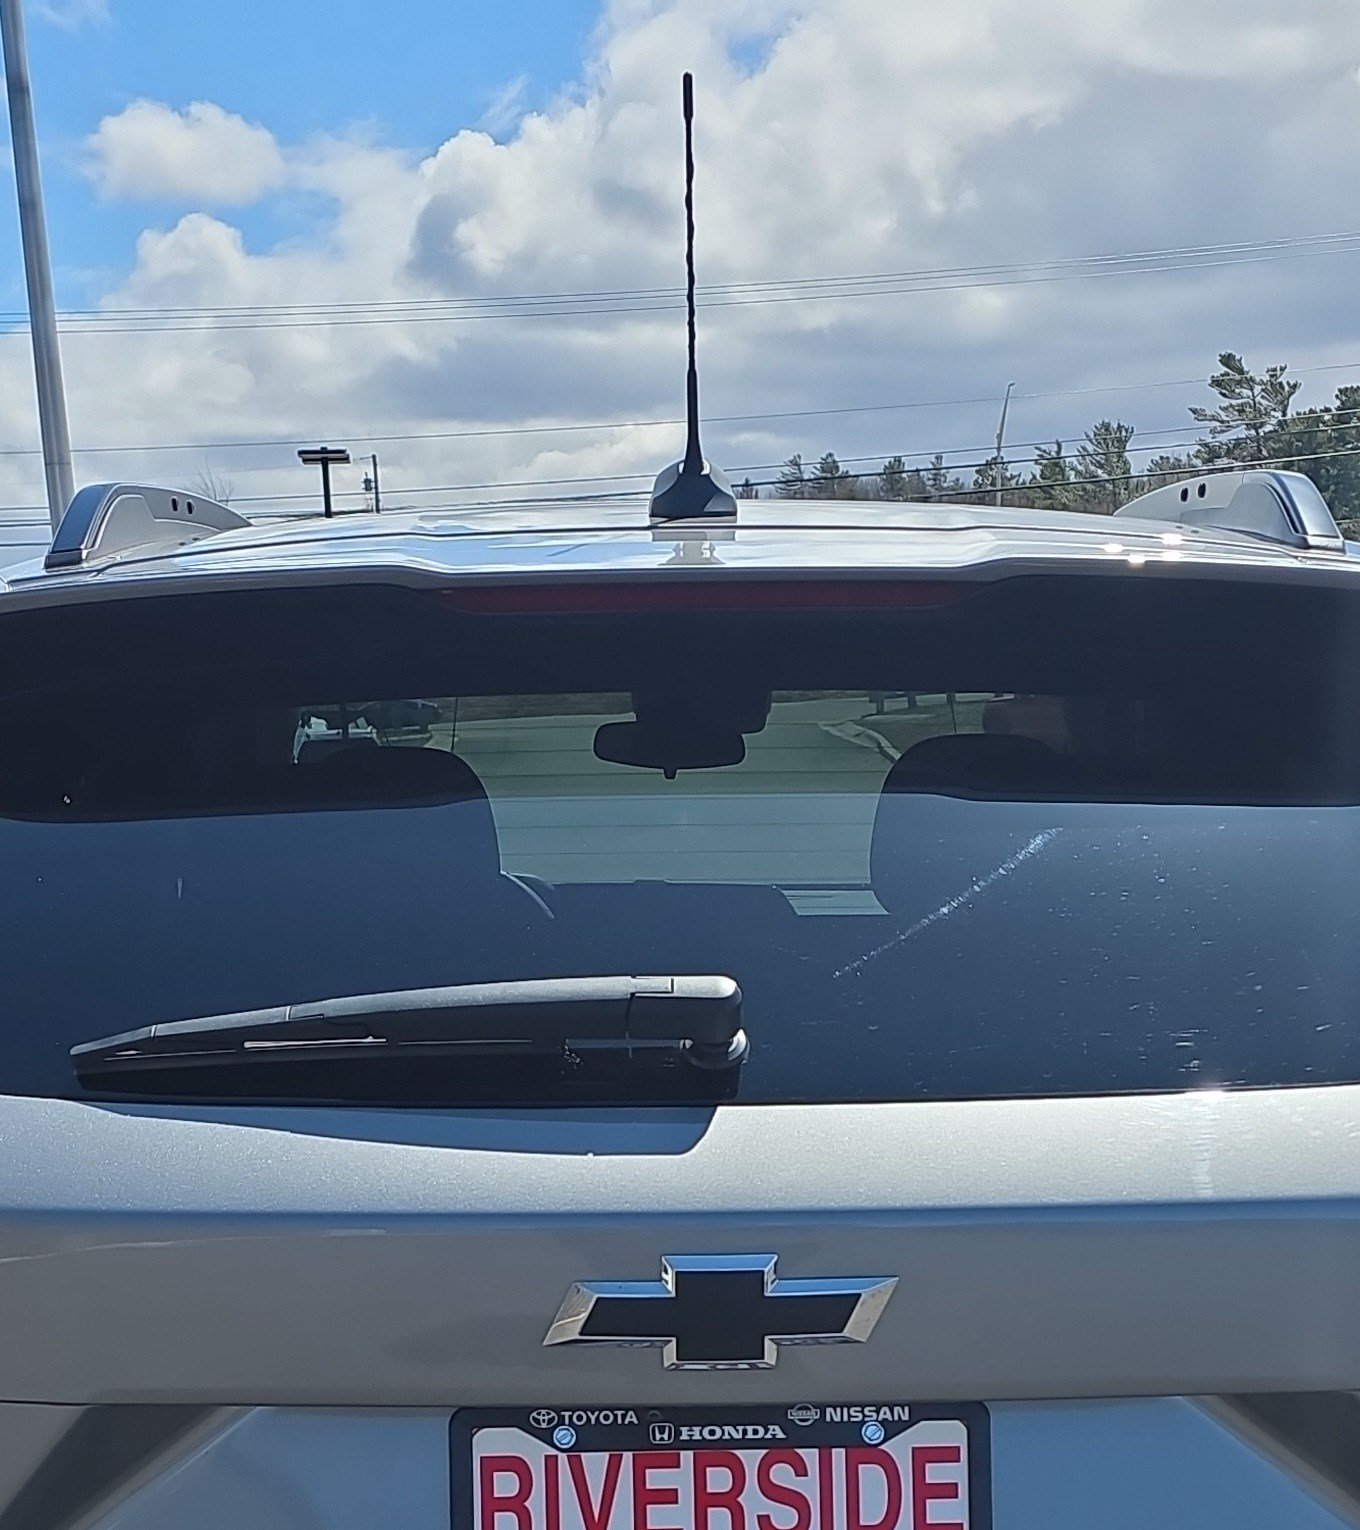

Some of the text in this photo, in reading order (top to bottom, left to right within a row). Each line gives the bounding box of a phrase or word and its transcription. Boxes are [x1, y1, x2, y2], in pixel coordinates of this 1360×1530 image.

[560, 1410, 639, 1426] TOYOTA
[825, 1405, 910, 1422] NISSAN
[679, 1424, 787, 1441] HONDA
